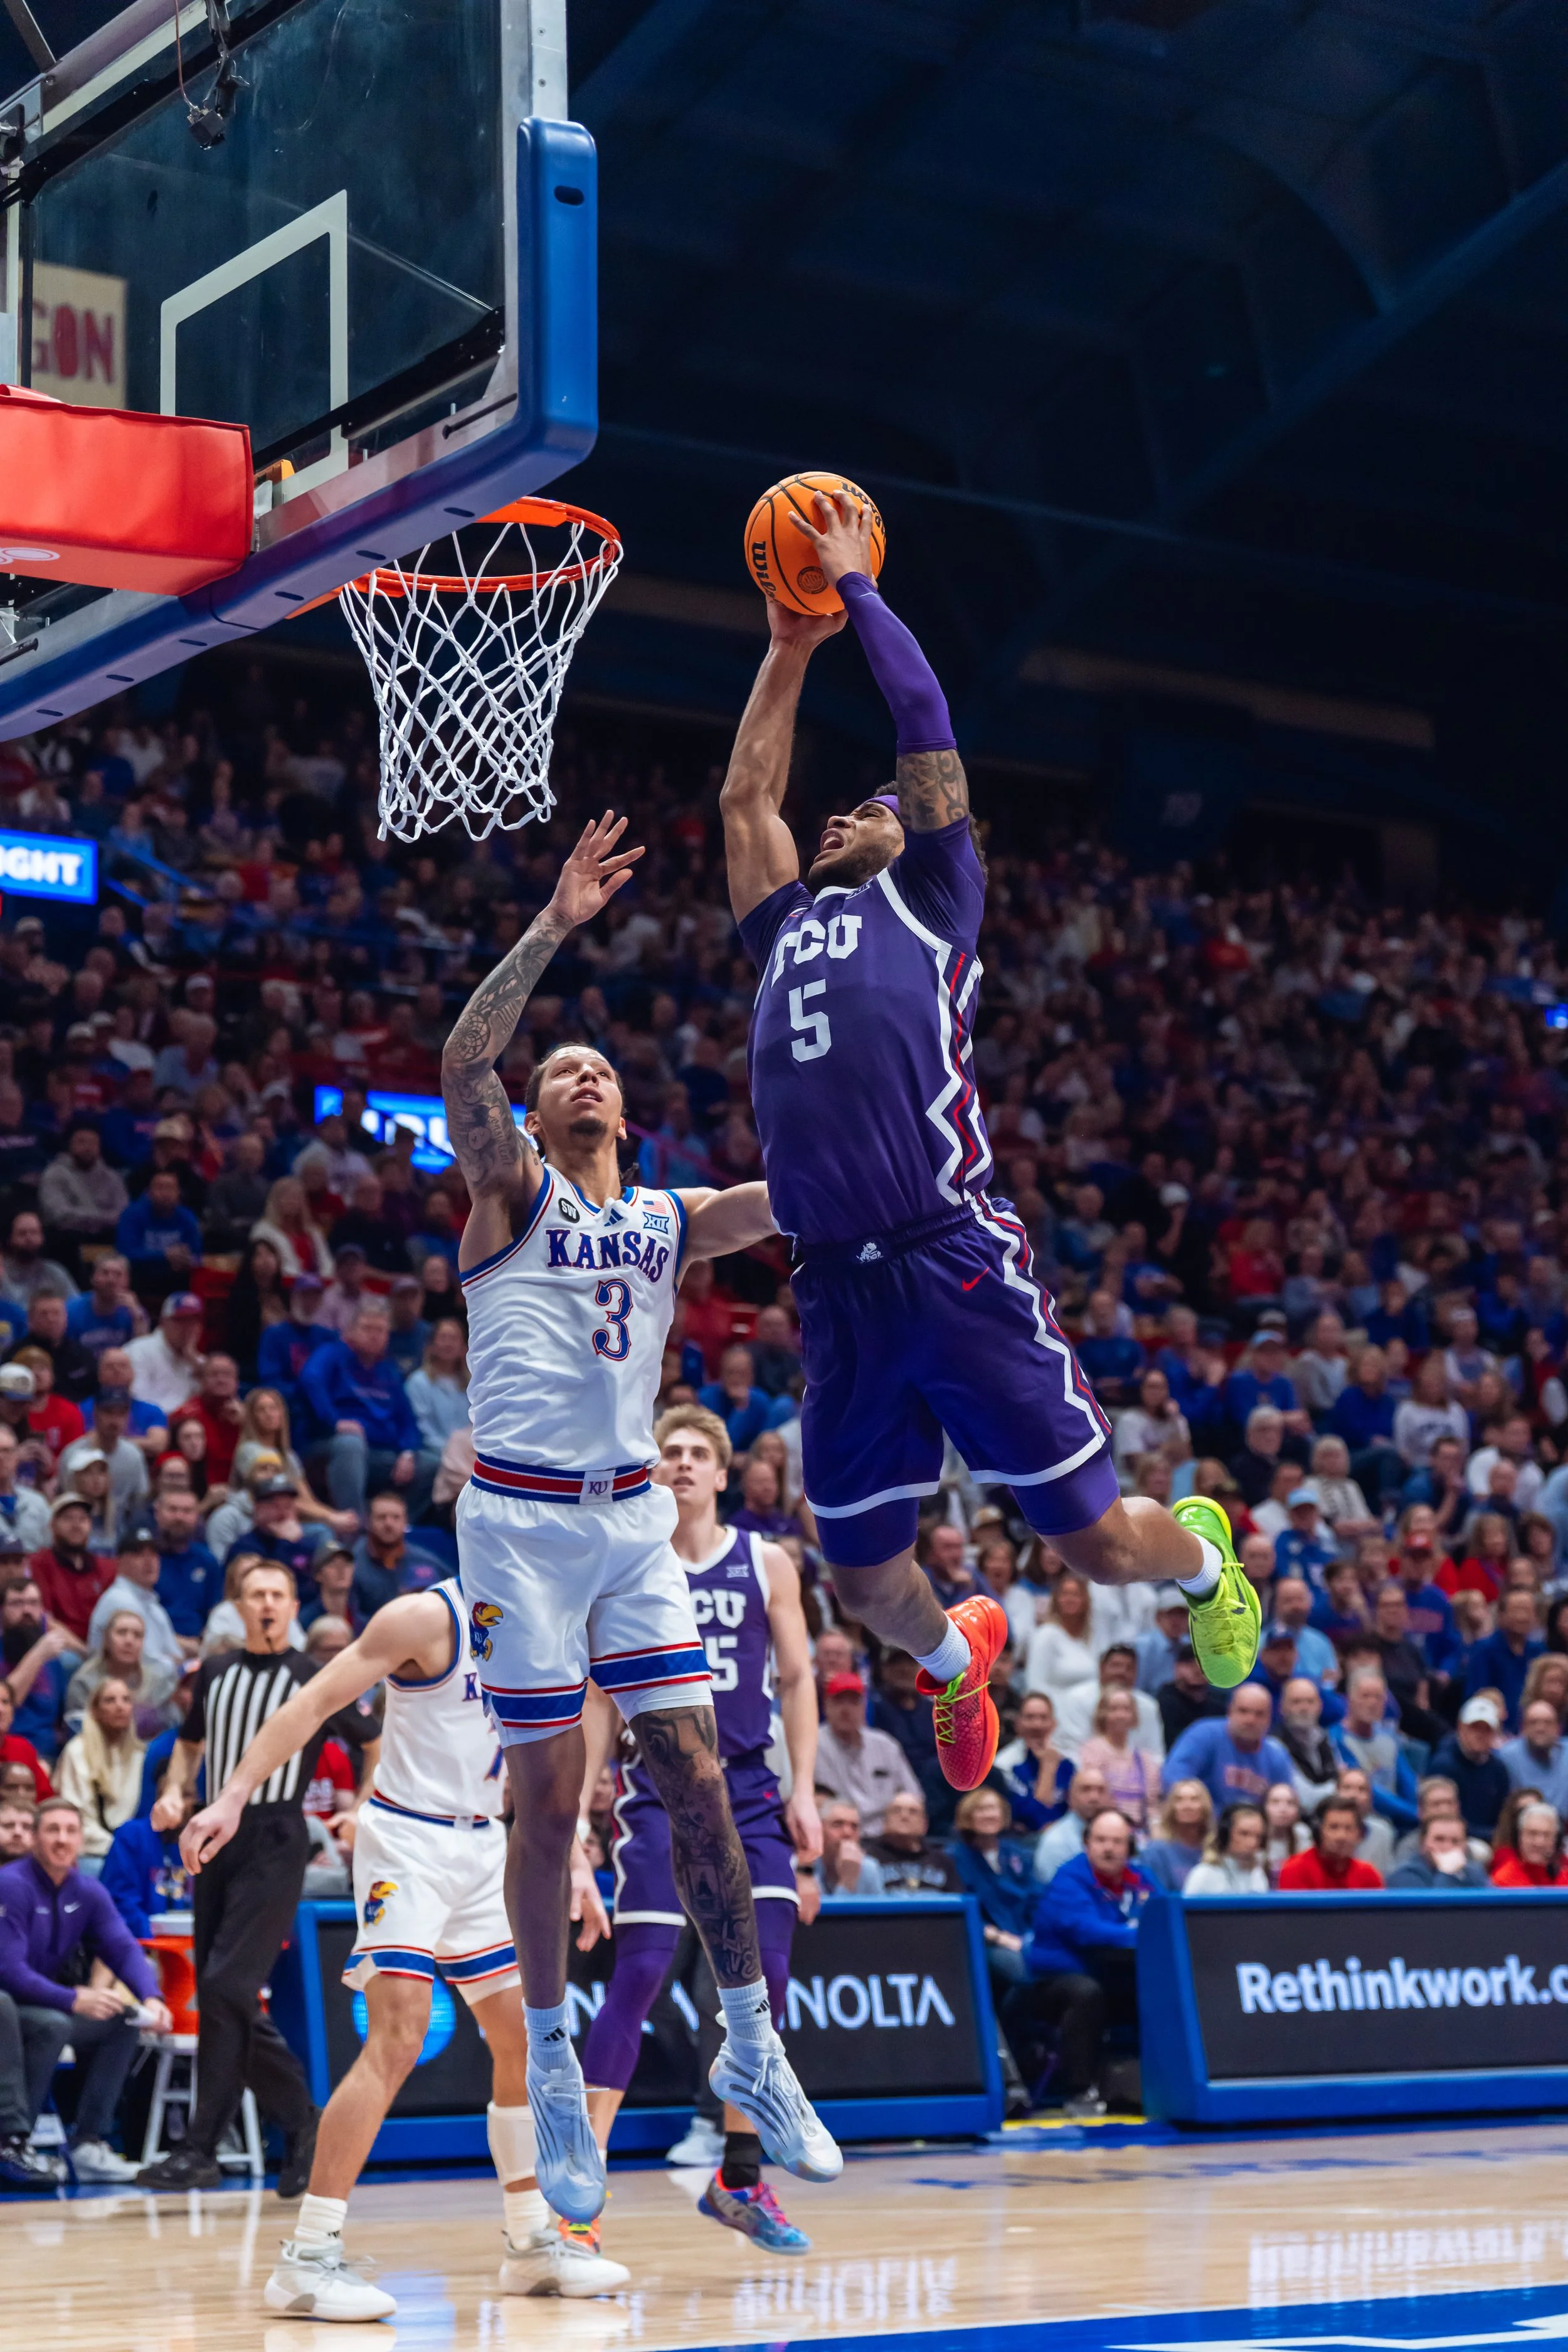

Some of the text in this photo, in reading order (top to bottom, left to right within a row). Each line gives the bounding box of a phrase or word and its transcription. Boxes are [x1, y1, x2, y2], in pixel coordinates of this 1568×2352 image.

[771, 914, 862, 988] TCU
[788, 978, 832, 1062] 5
[561, 1200, 577, 1220] SW
[545, 1229, 669, 1283] KANSAS
[592, 1278, 633, 1362] 3
[588, 1480, 608, 1495] KU
[690, 1589, 746, 1629] CU
[778, 1974, 956, 2032] NOLTA
